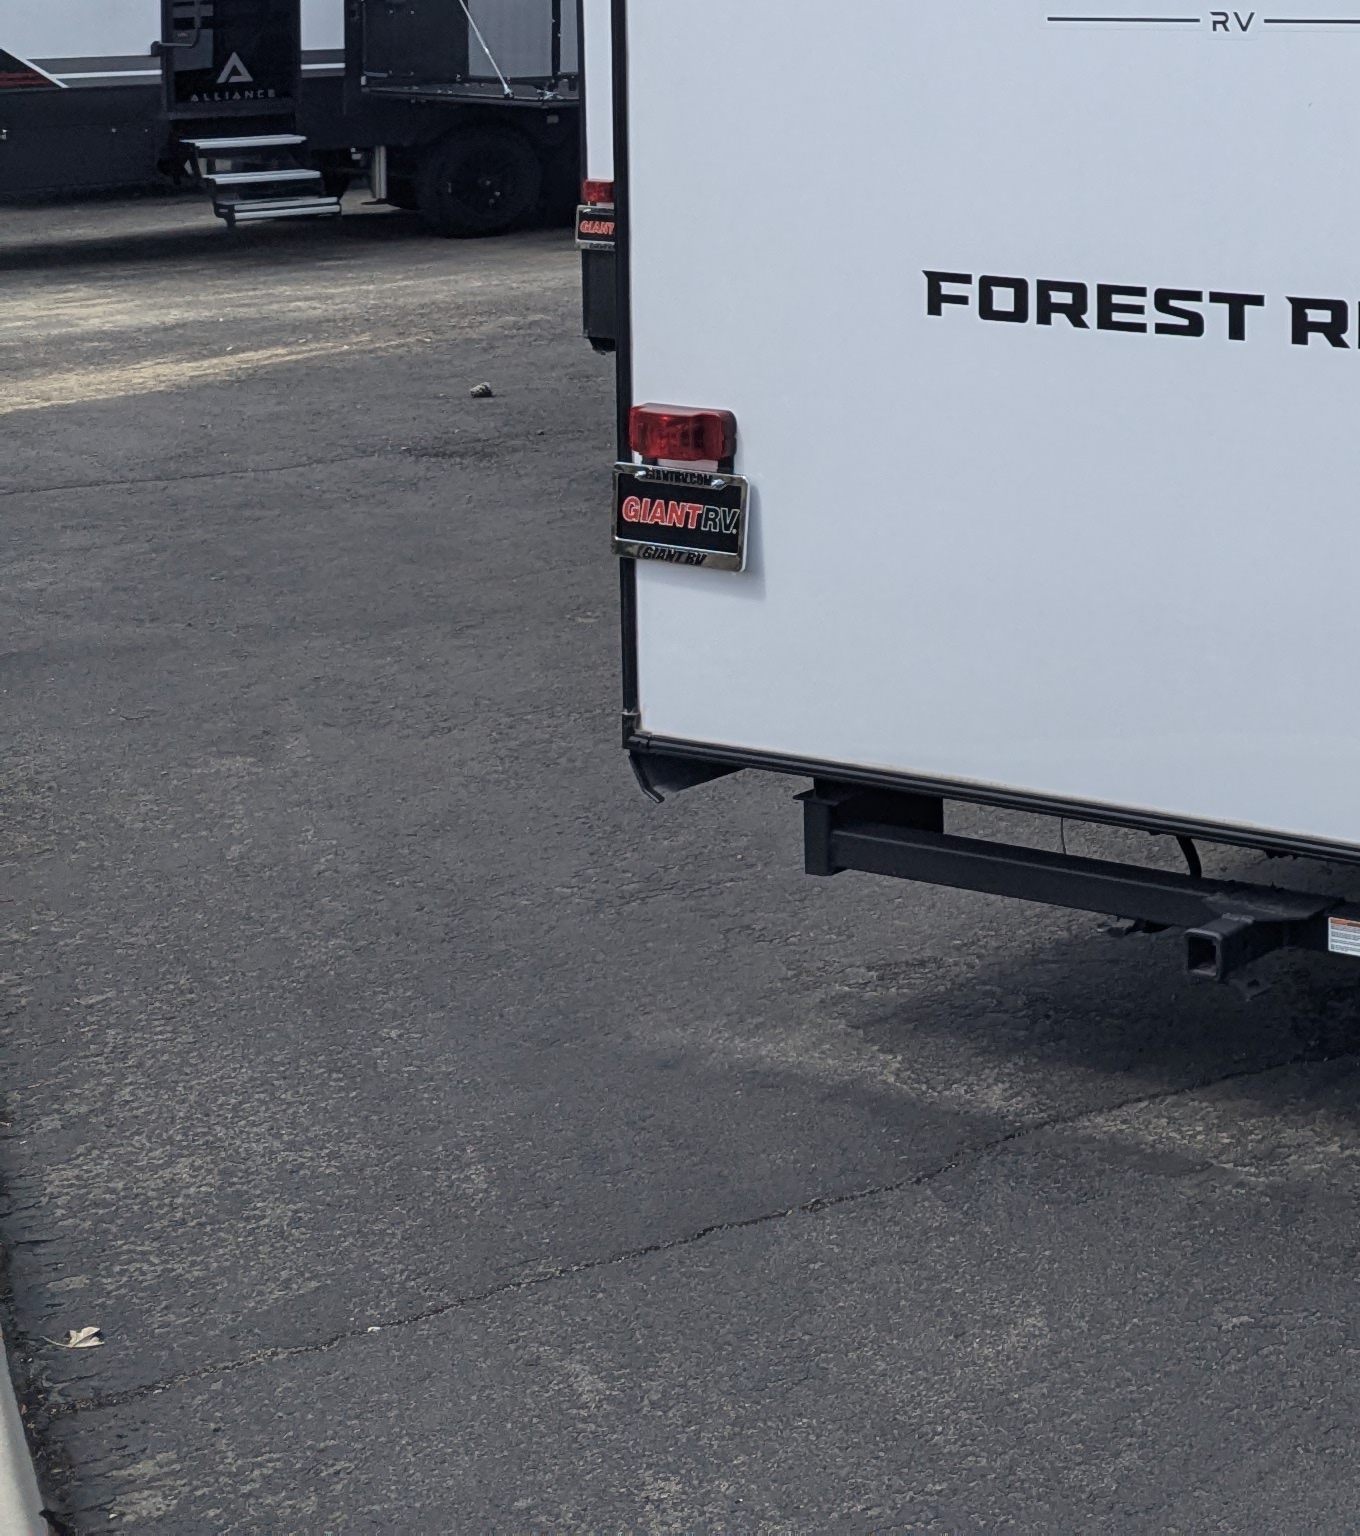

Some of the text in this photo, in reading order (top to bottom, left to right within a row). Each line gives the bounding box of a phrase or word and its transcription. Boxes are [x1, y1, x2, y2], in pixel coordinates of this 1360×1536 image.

[1210, 11, 1255, 32] RV
[190, 88, 276, 102] ALLIANCE
[921, 269, 1265, 342] FOREST
[642, 546, 708, 566] GIANT RV
